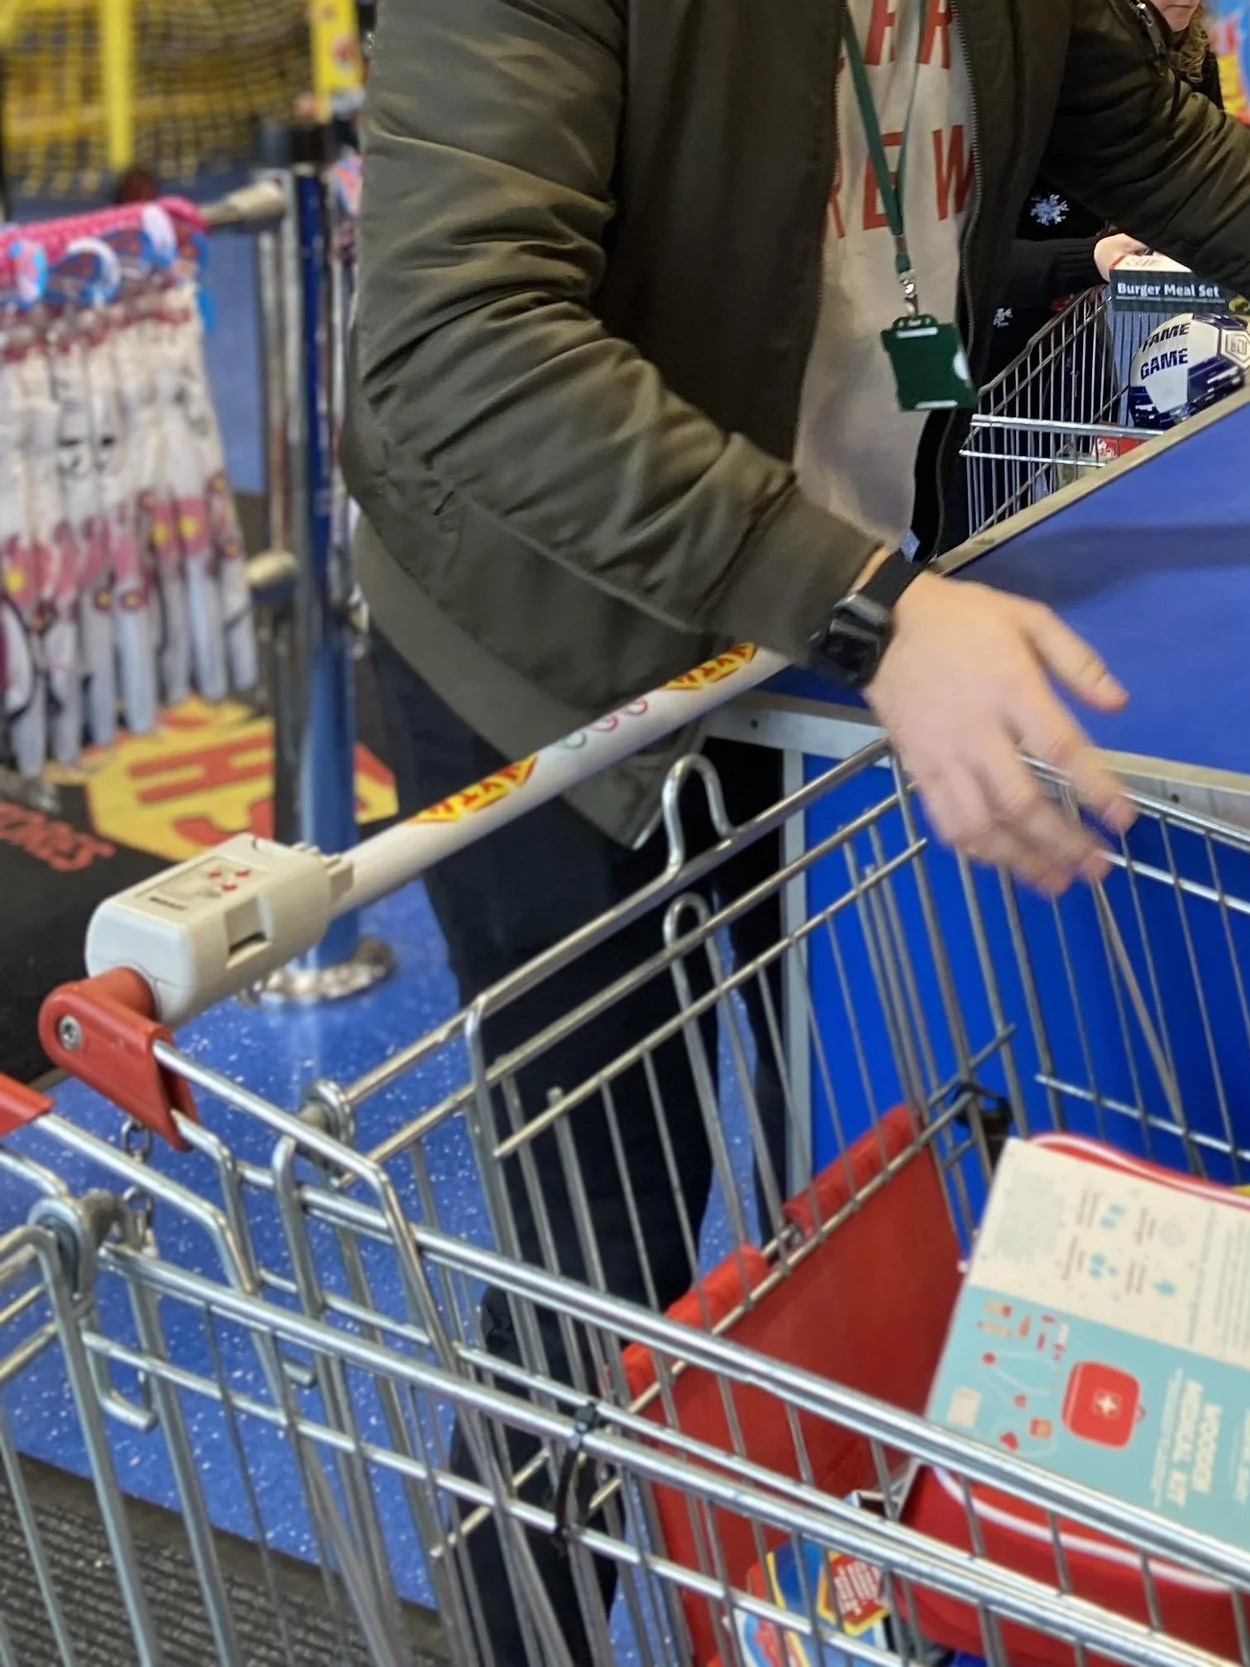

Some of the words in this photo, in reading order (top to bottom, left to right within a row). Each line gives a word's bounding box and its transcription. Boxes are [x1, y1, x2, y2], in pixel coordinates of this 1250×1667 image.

[1117, 282, 1161, 297] Burger
[1164, 284, 1195, 297] Meal
[1198, 284, 1220, 298] Set
[1140, 348, 1189, 381] GAME
